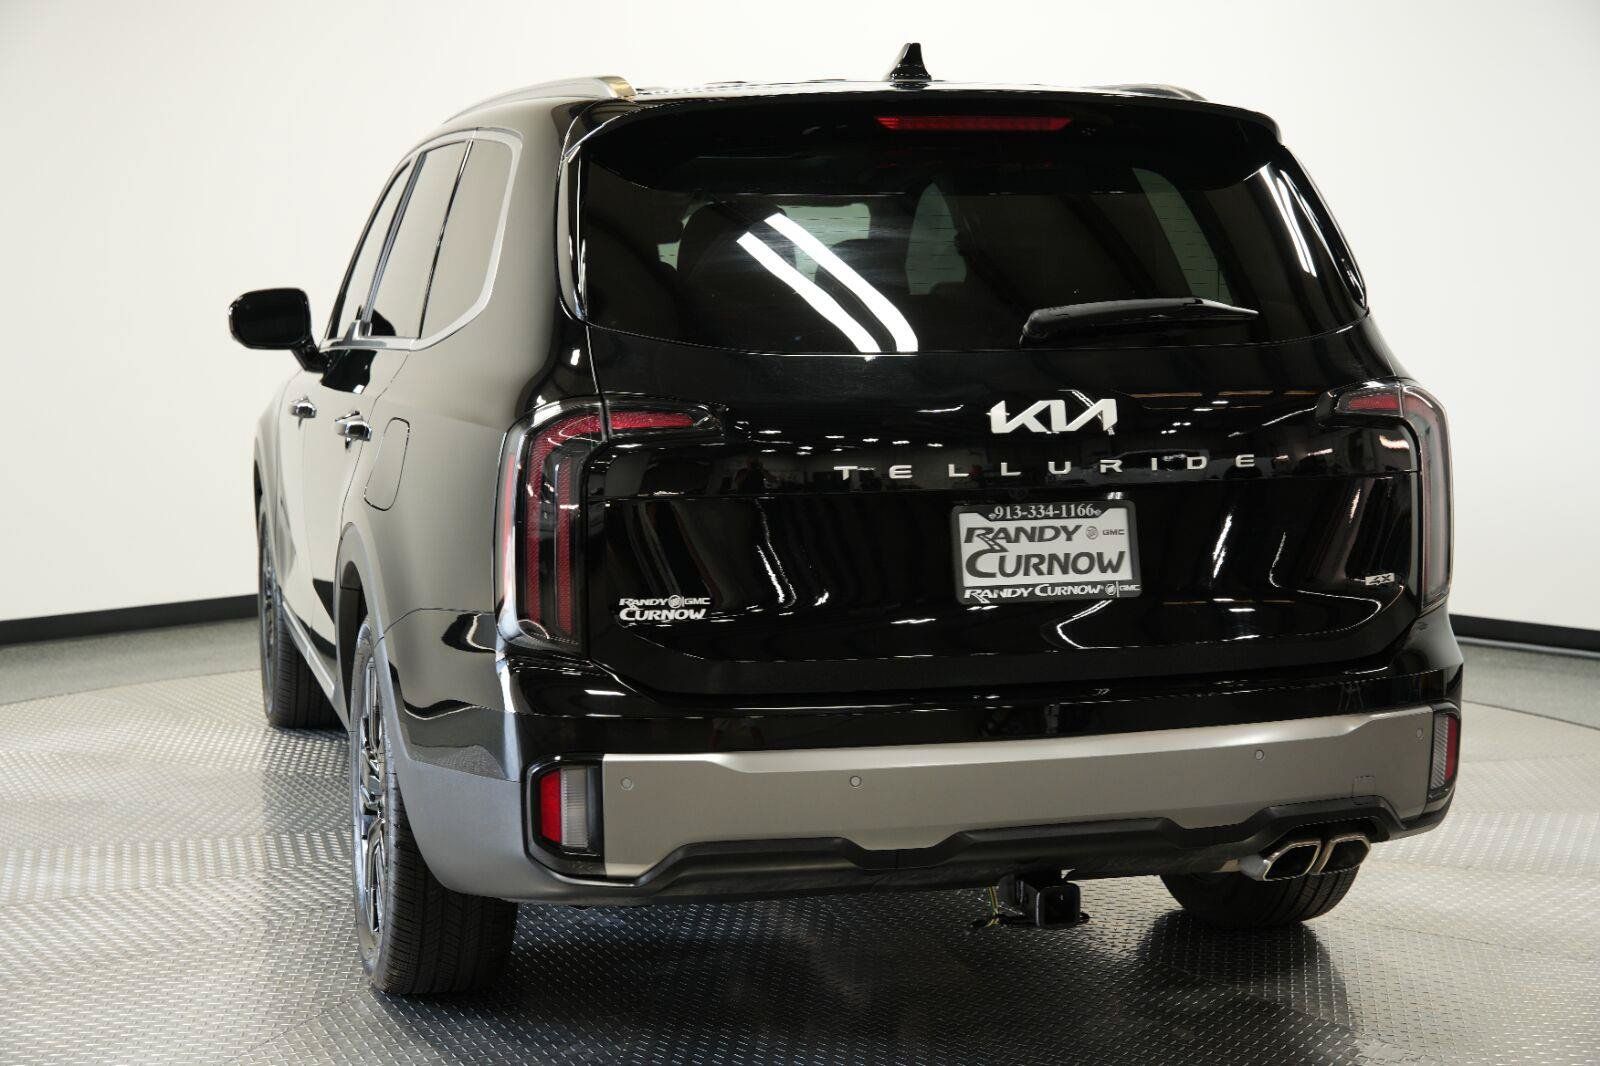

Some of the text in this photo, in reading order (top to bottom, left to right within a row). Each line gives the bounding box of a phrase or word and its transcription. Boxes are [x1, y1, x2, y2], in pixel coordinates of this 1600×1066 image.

[990, 398, 1118, 434] KIA
[833, 453, 1255, 480] TELLURIDE
[994, 503, 1094, 519] 913-334-1166
[964, 525, 1125, 546] RANDY GMC
[965, 550, 1126, 578] CURNOW
[619, 598, 669, 607] RANDY
[964, 587, 1033, 602] RANDY
[1035, 584, 1101, 596] CURNOW
[619, 608, 707, 620] CURNOW
